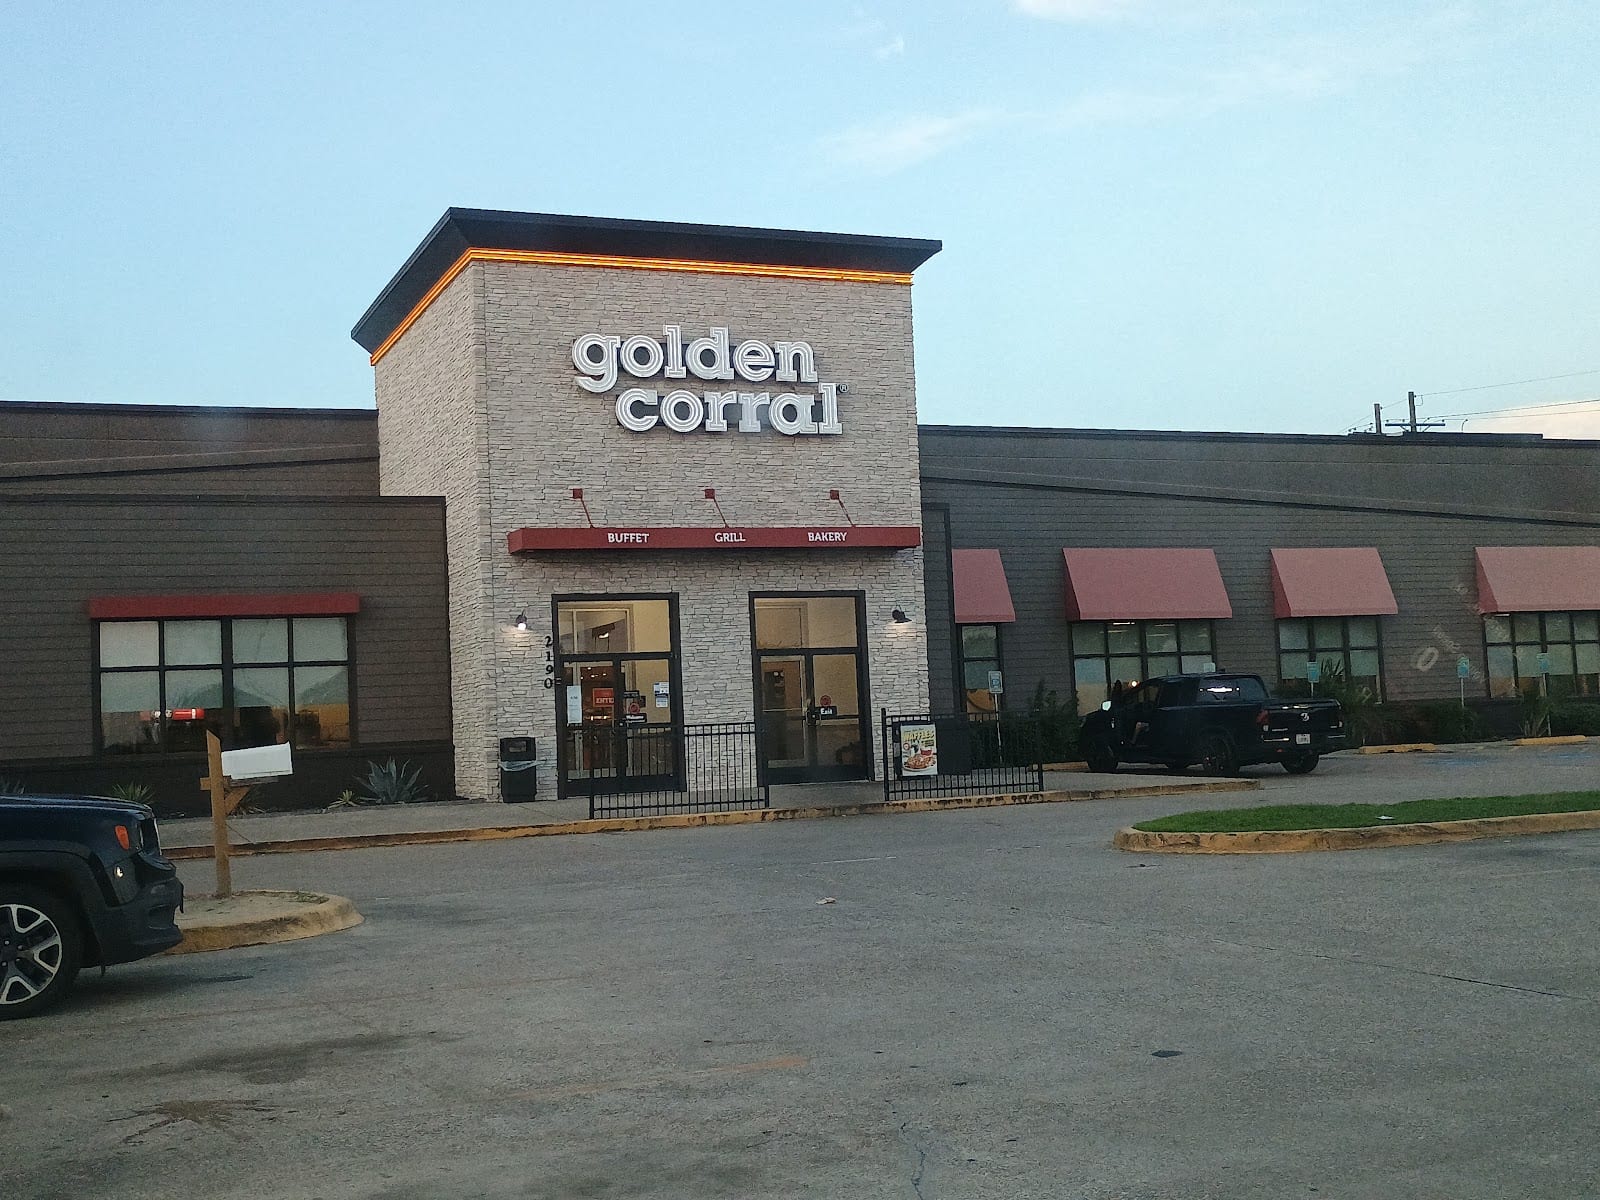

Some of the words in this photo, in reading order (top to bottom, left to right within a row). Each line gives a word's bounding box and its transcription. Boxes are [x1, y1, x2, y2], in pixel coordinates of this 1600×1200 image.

[572, 325, 819, 393] golden
[616, 383, 843, 435] corral
[607, 532, 650, 544] BUFFET
[714, 532, 746, 543] GRILL
[807, 532, 848, 542] BAKERY
